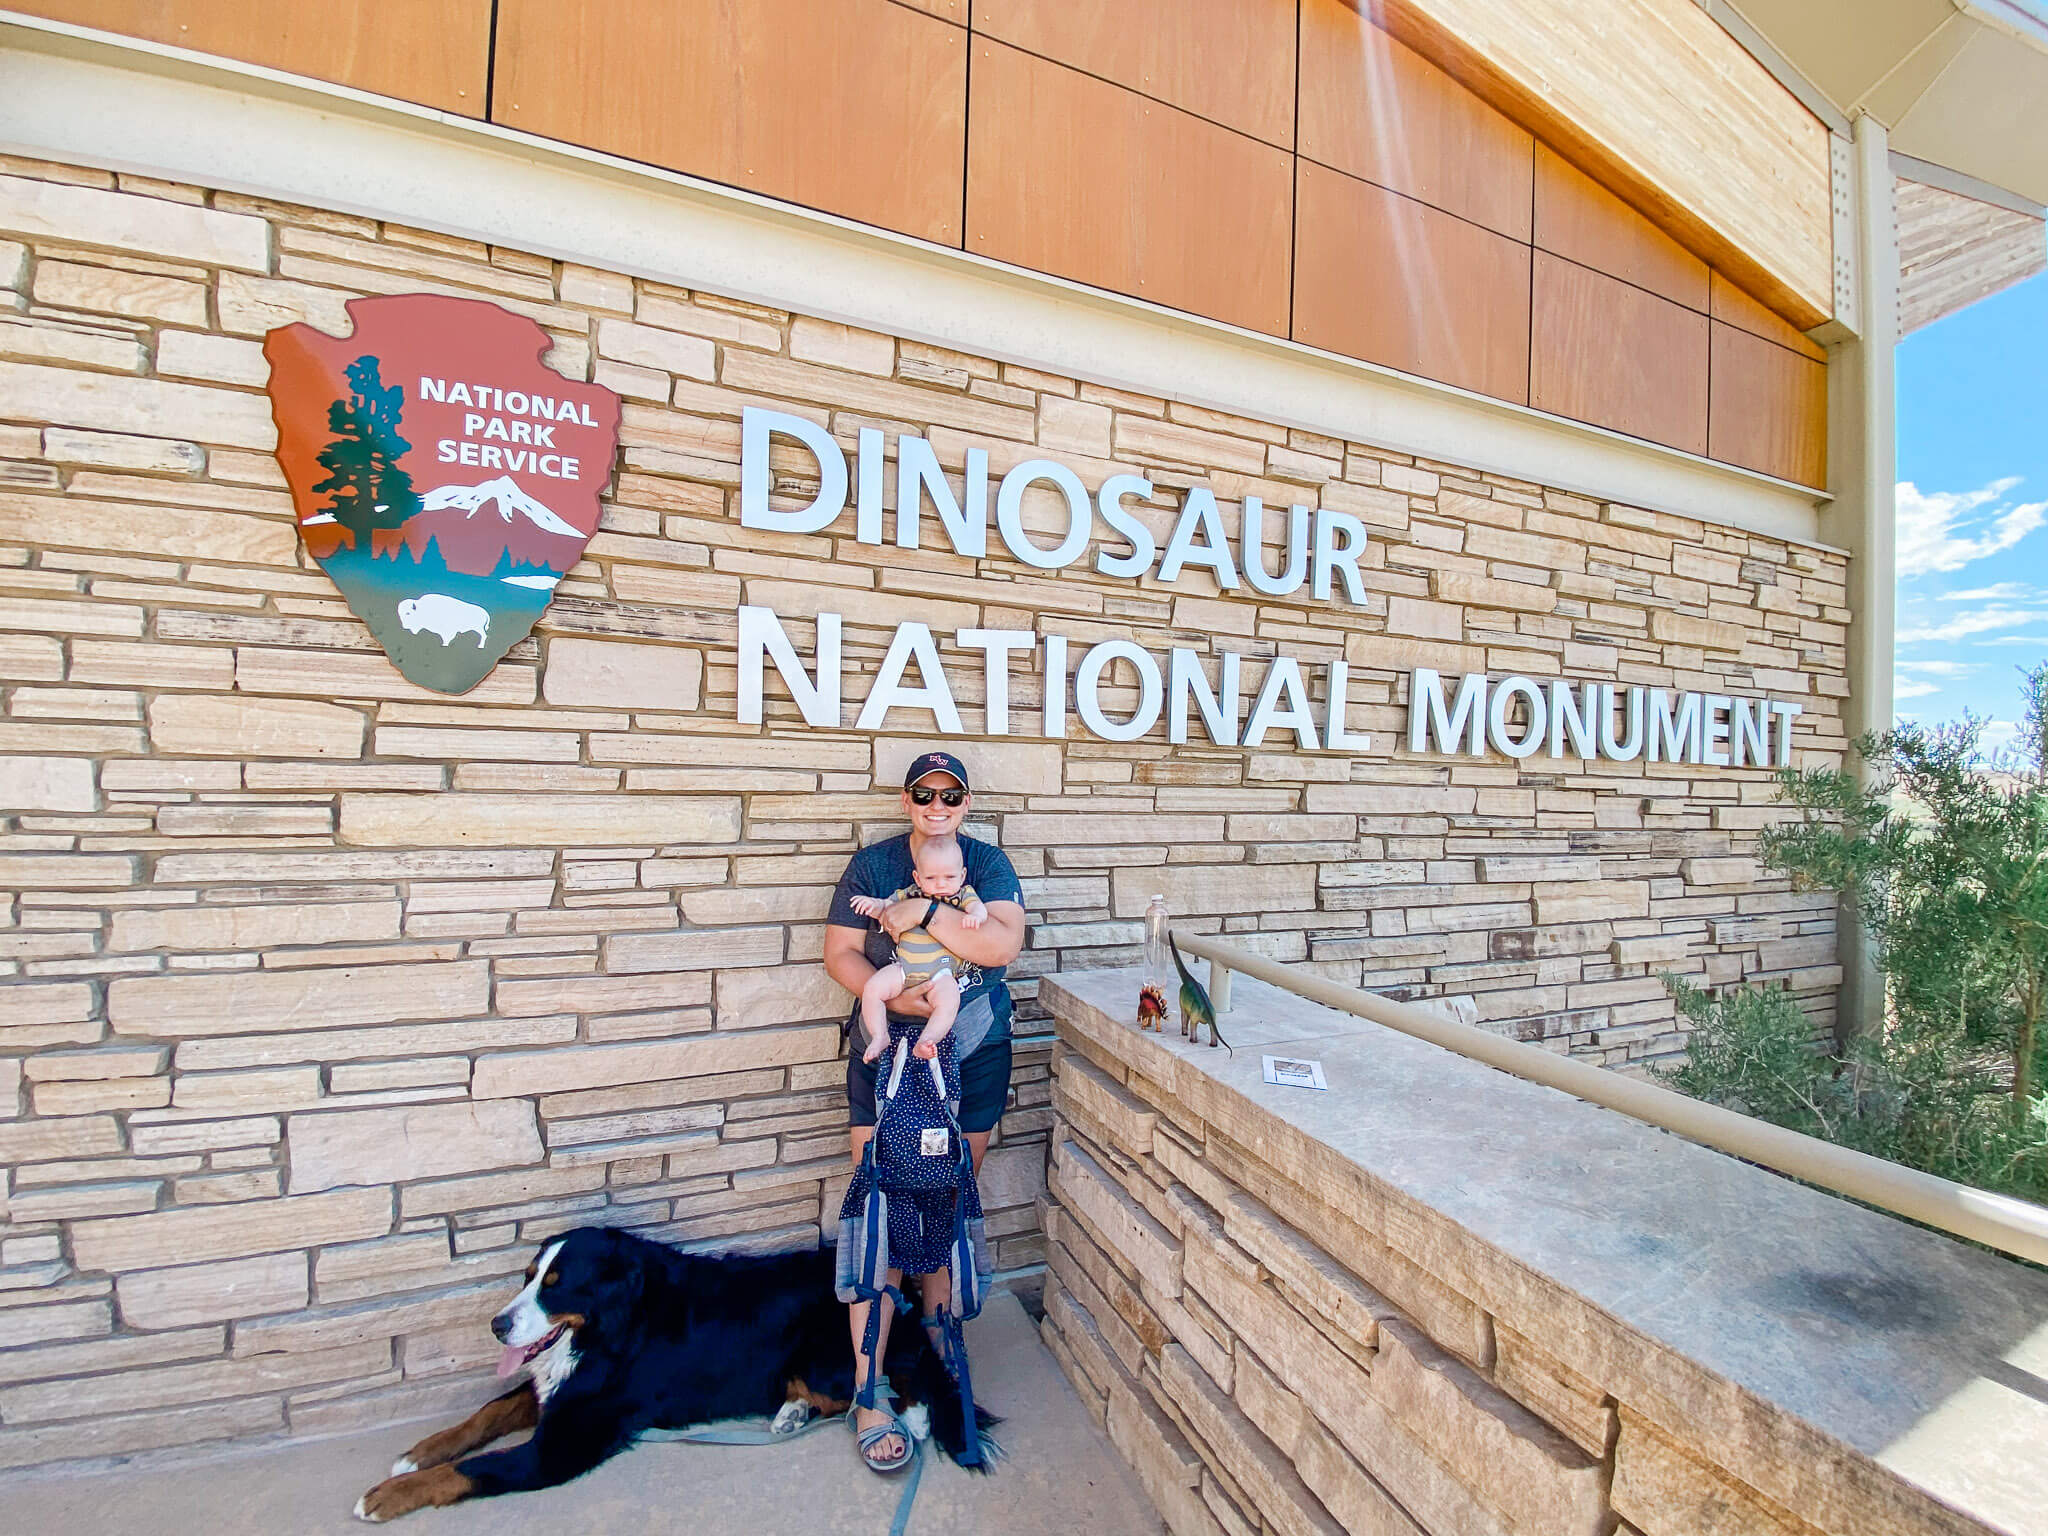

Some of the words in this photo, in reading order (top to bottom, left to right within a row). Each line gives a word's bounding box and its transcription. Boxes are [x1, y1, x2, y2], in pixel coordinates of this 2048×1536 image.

[420, 376, 599, 428] NATIONAL
[464, 413, 556, 449] PARK
[437, 439, 581, 480] SERVICE
[740, 405, 1369, 606] DINOSAUR
[737, 604, 1371, 751] NATIONAL
[1408, 667, 1802, 767] MONUMENT
